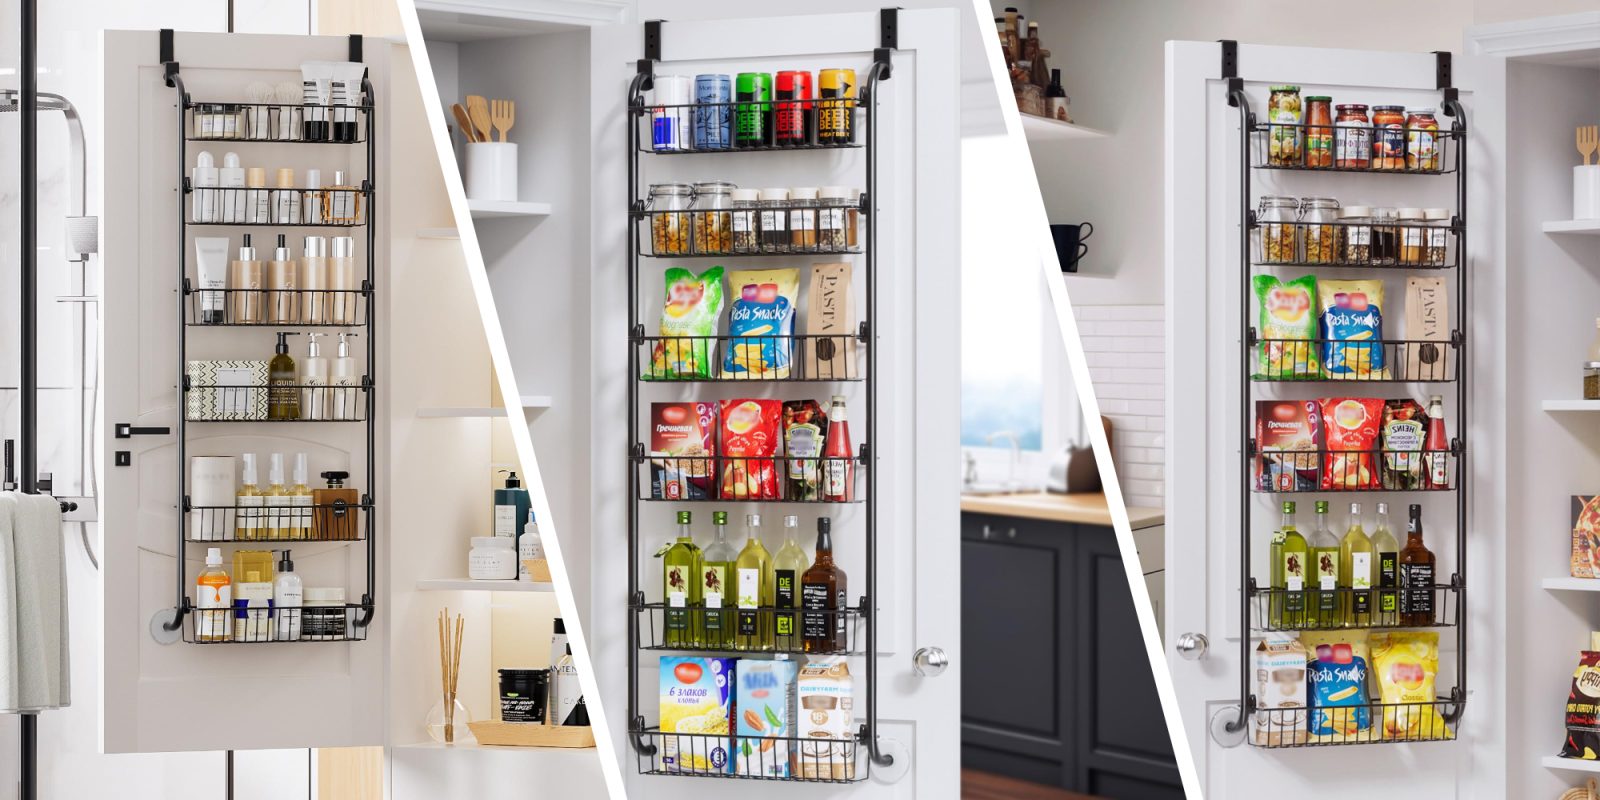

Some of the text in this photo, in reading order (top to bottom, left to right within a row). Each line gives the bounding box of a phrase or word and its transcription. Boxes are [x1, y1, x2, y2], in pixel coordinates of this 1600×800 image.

[819, 109, 850, 119] DEER
[819, 119, 850, 130] BEER
[822, 275, 838, 331] PASTA
[730, 303, 786, 321] Pasta Snacks
[1422, 288, 1437, 337] PASTA
[1327, 312, 1350, 326] Pasta
[1383, 559, 1393, 568] DE
[779, 577, 791, 586] DE
[1307, 667, 1333, 683] Pasta
[669, 686, 708, 697] 6 злаков
